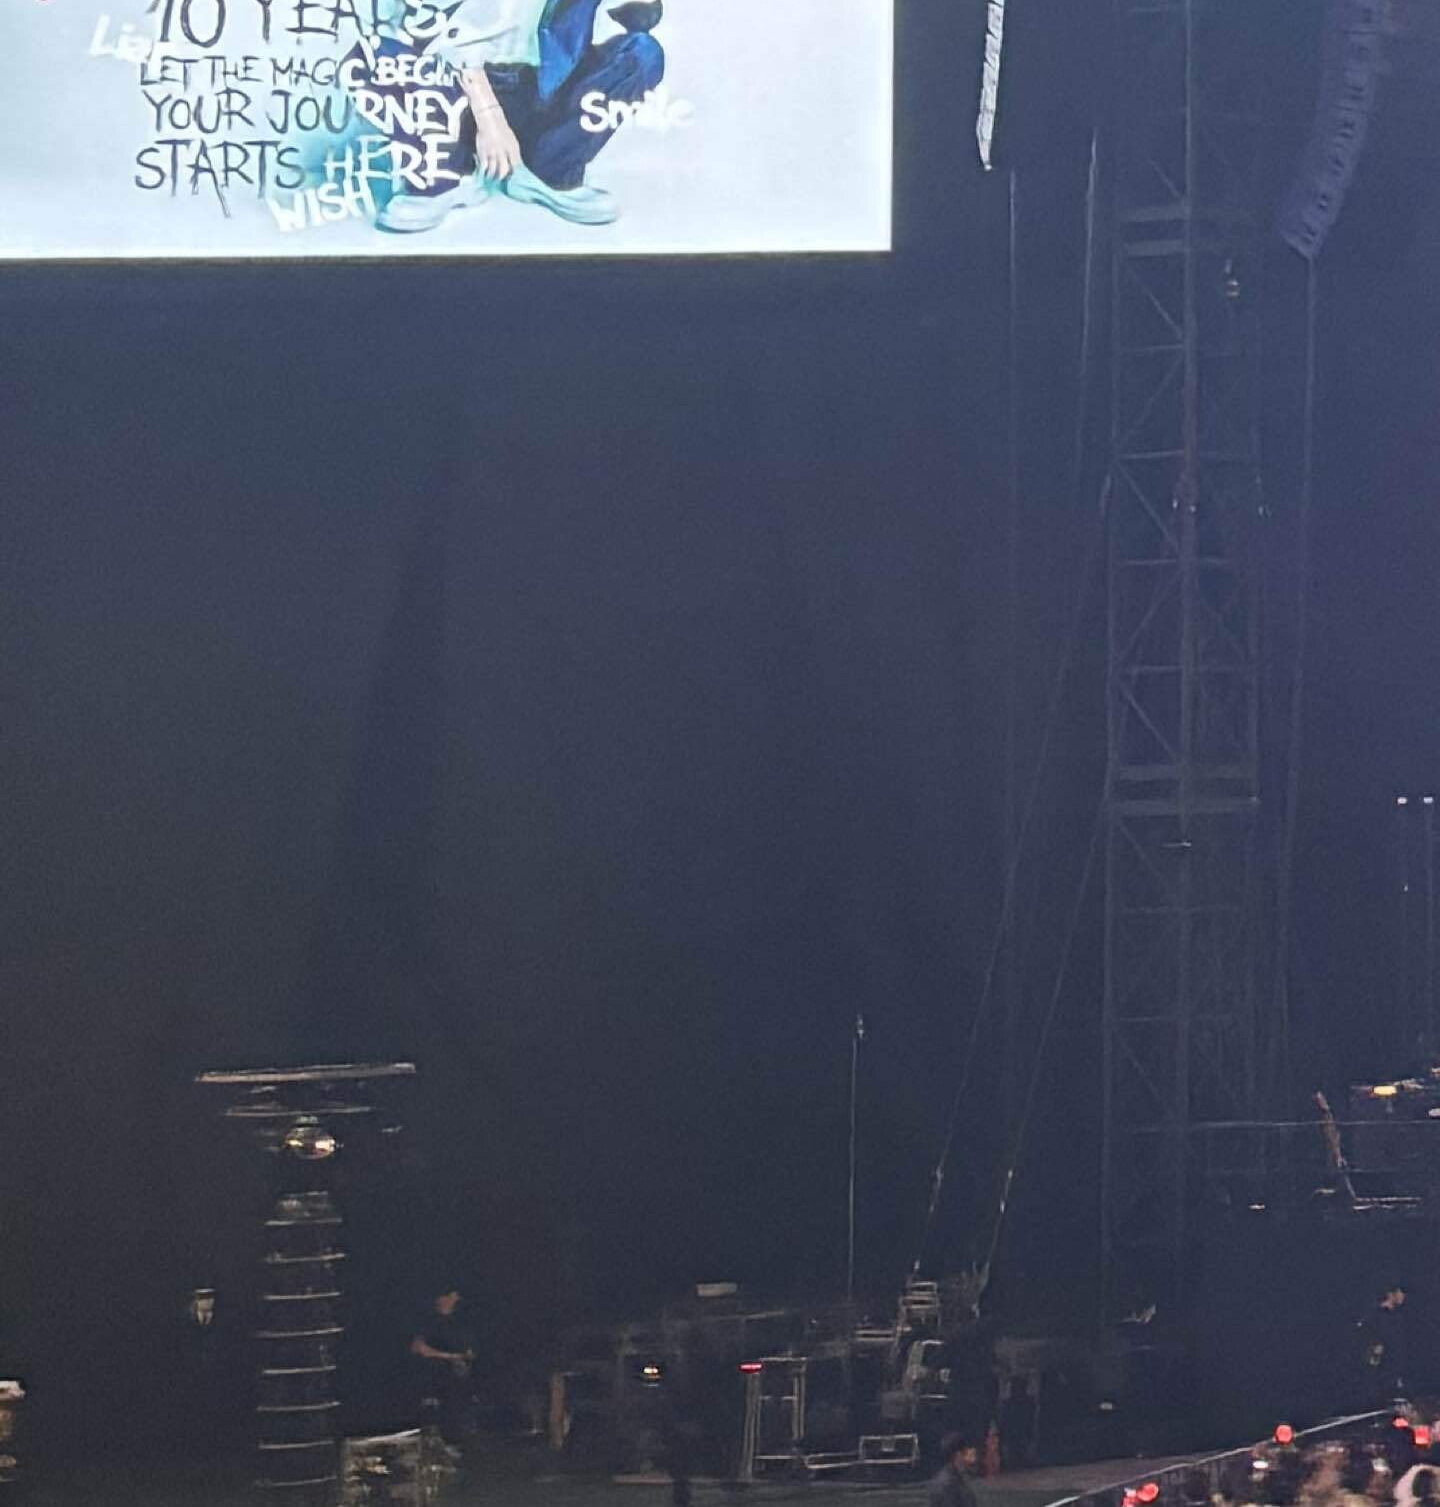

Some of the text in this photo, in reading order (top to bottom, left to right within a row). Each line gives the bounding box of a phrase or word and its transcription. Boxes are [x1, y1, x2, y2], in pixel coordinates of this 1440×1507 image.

[140, 55, 203, 89] LET
[206, 54, 264, 87] THE
[142, 87, 469, 139] YOUR JOURNEY
[134, 133, 465, 216] STARTS HERE
[267, 174, 378, 234] WISH
